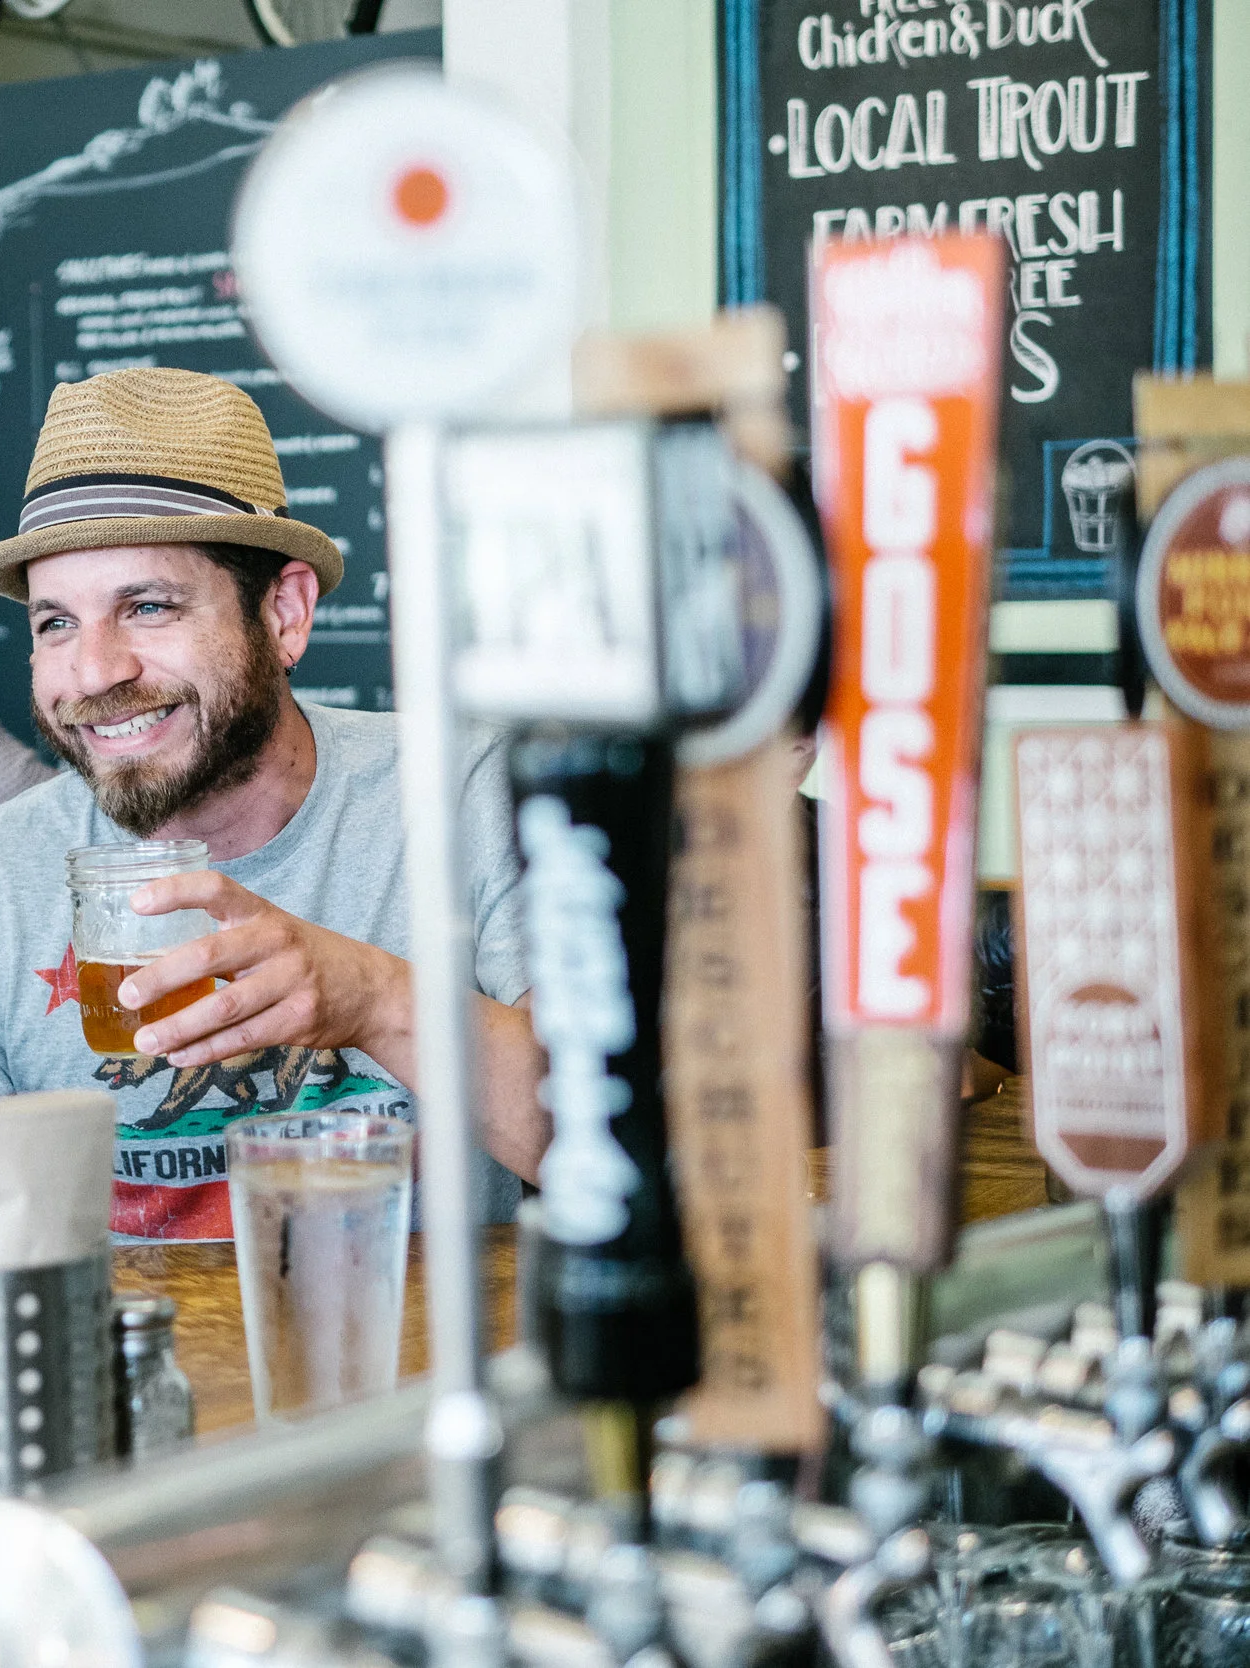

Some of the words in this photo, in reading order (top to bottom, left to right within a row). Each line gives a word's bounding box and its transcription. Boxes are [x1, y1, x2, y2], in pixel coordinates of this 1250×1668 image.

[787, 90, 958, 179] LOCAL
[966, 71, 1150, 172] TROUT
[855, 400, 941, 1016] GOSE
